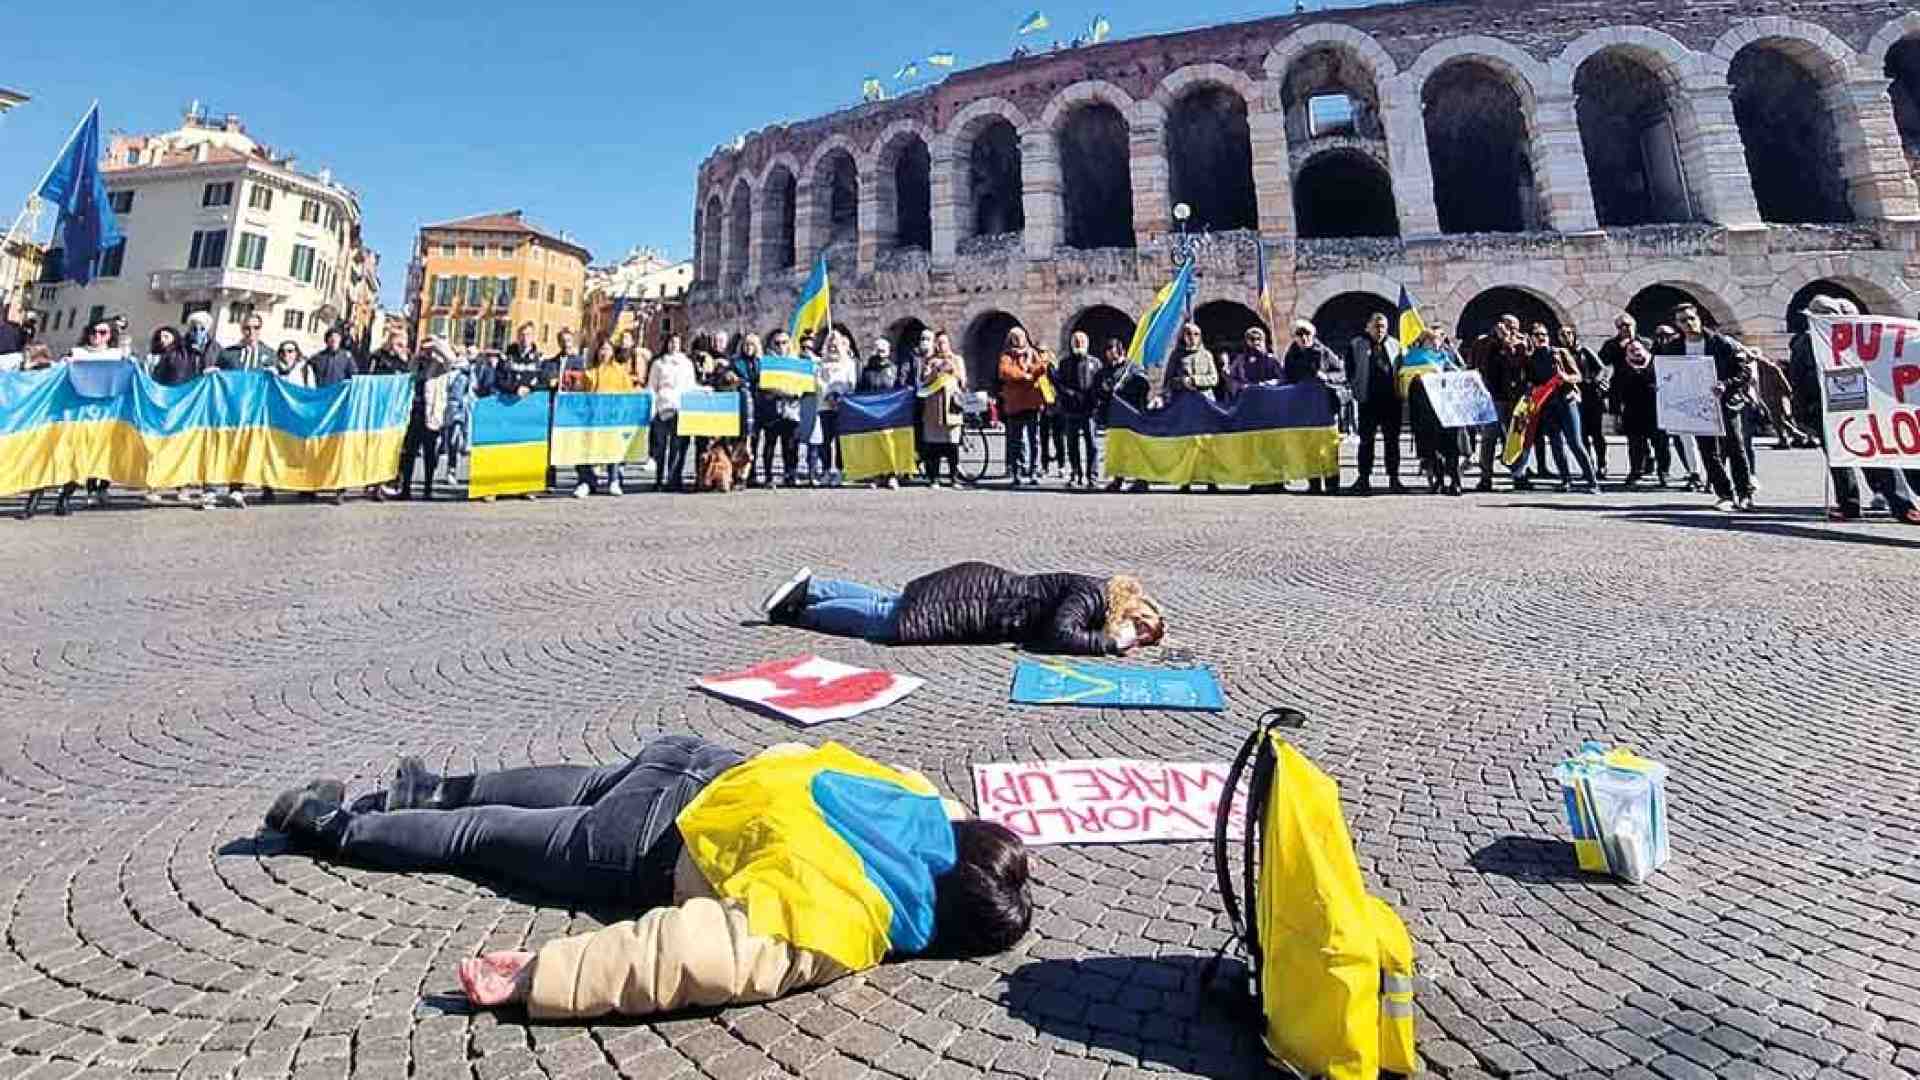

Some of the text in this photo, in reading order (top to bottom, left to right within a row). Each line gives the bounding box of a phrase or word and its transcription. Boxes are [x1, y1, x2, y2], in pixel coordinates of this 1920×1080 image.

[1831, 321, 1918, 367] PUT
[1838, 409, 1920, 458] GLO
[978, 767, 1246, 806] WAKE UP!
